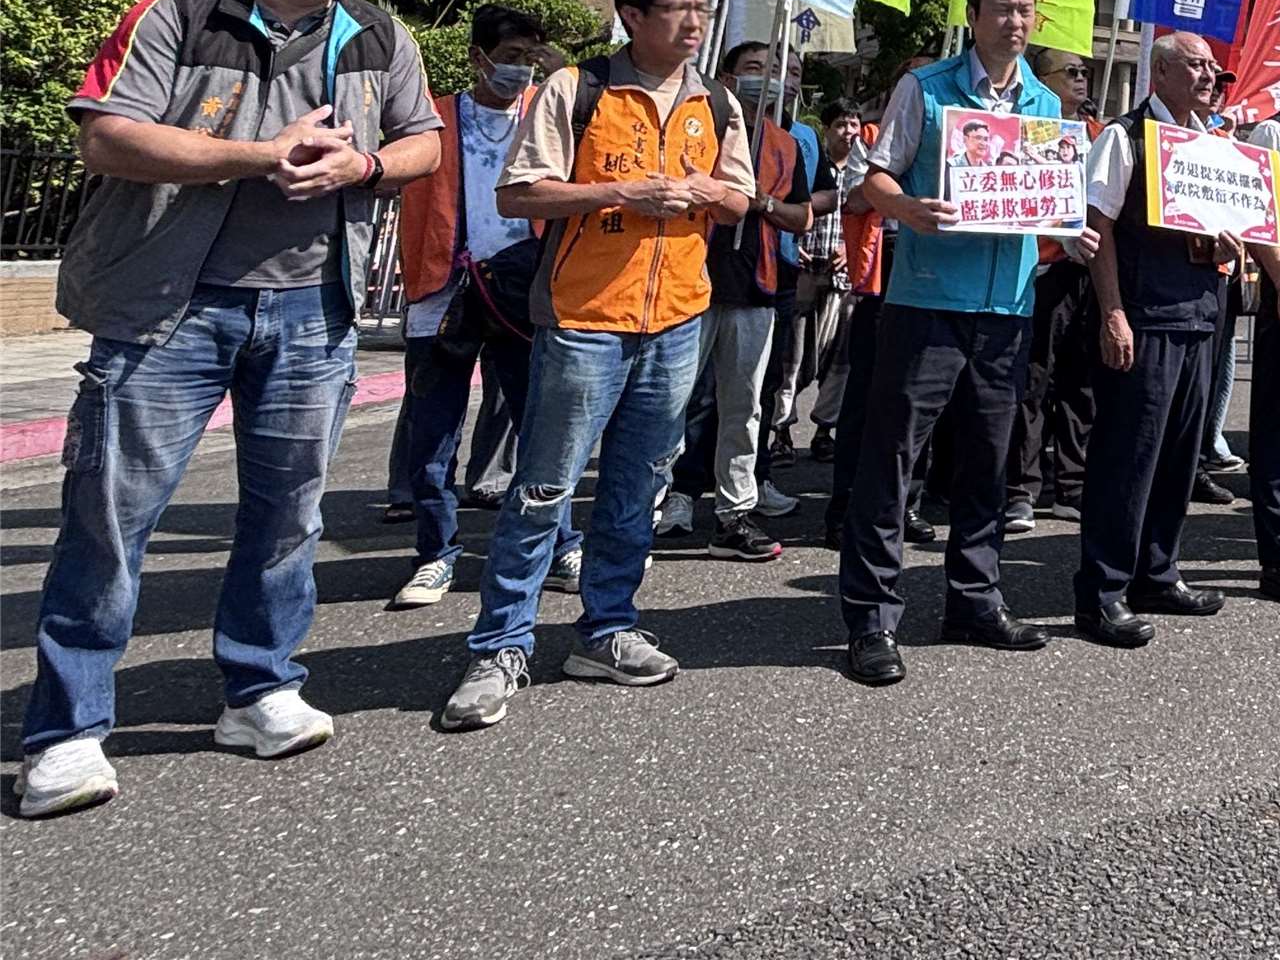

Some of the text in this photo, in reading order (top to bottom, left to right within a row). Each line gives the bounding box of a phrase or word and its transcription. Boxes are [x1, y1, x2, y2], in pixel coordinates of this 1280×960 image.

[600, 152, 631, 234] 姚祖
[959, 169, 1074, 193] 立委無心修法
[960, 196, 1076, 222] 藍綠欺騙勞工
